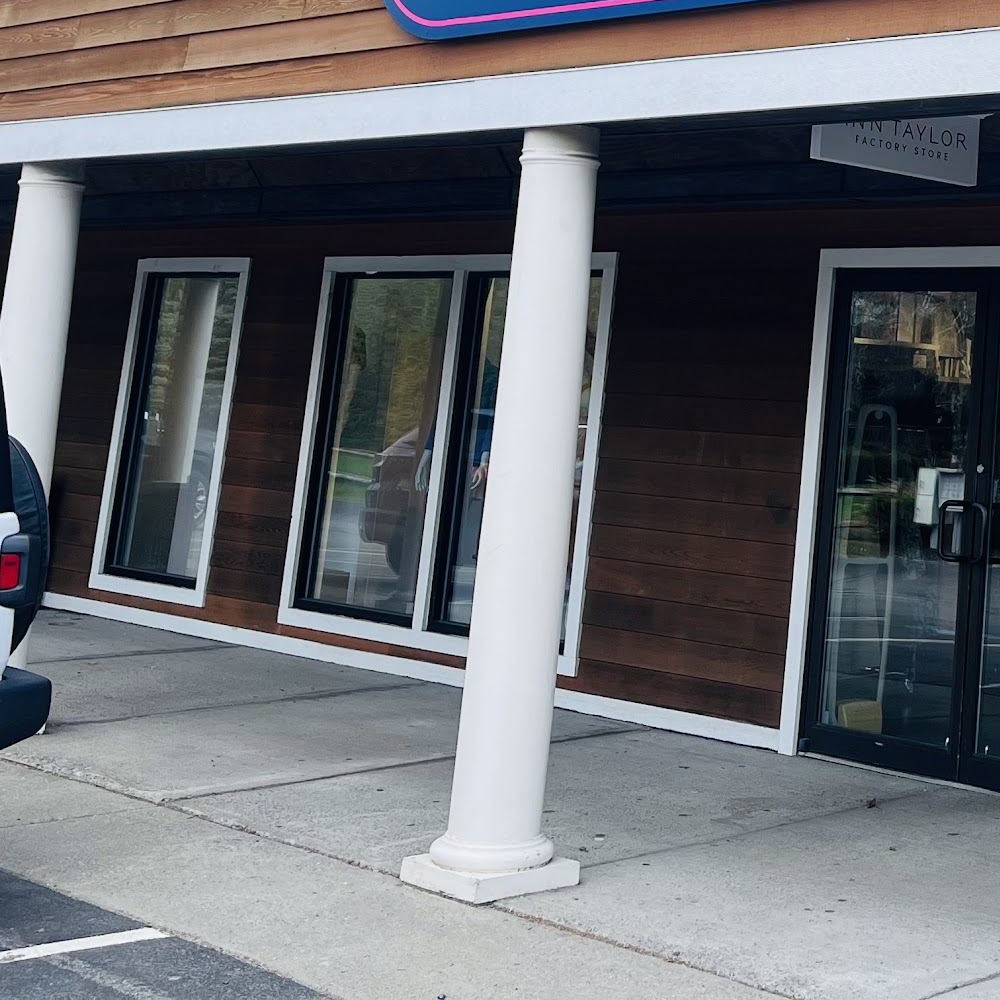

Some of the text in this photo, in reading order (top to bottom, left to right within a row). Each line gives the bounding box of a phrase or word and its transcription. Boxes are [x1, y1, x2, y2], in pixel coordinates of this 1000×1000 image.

[845, 120, 967, 151] NN TAYLOR
[855, 134, 949, 161] FACTORY STORE
